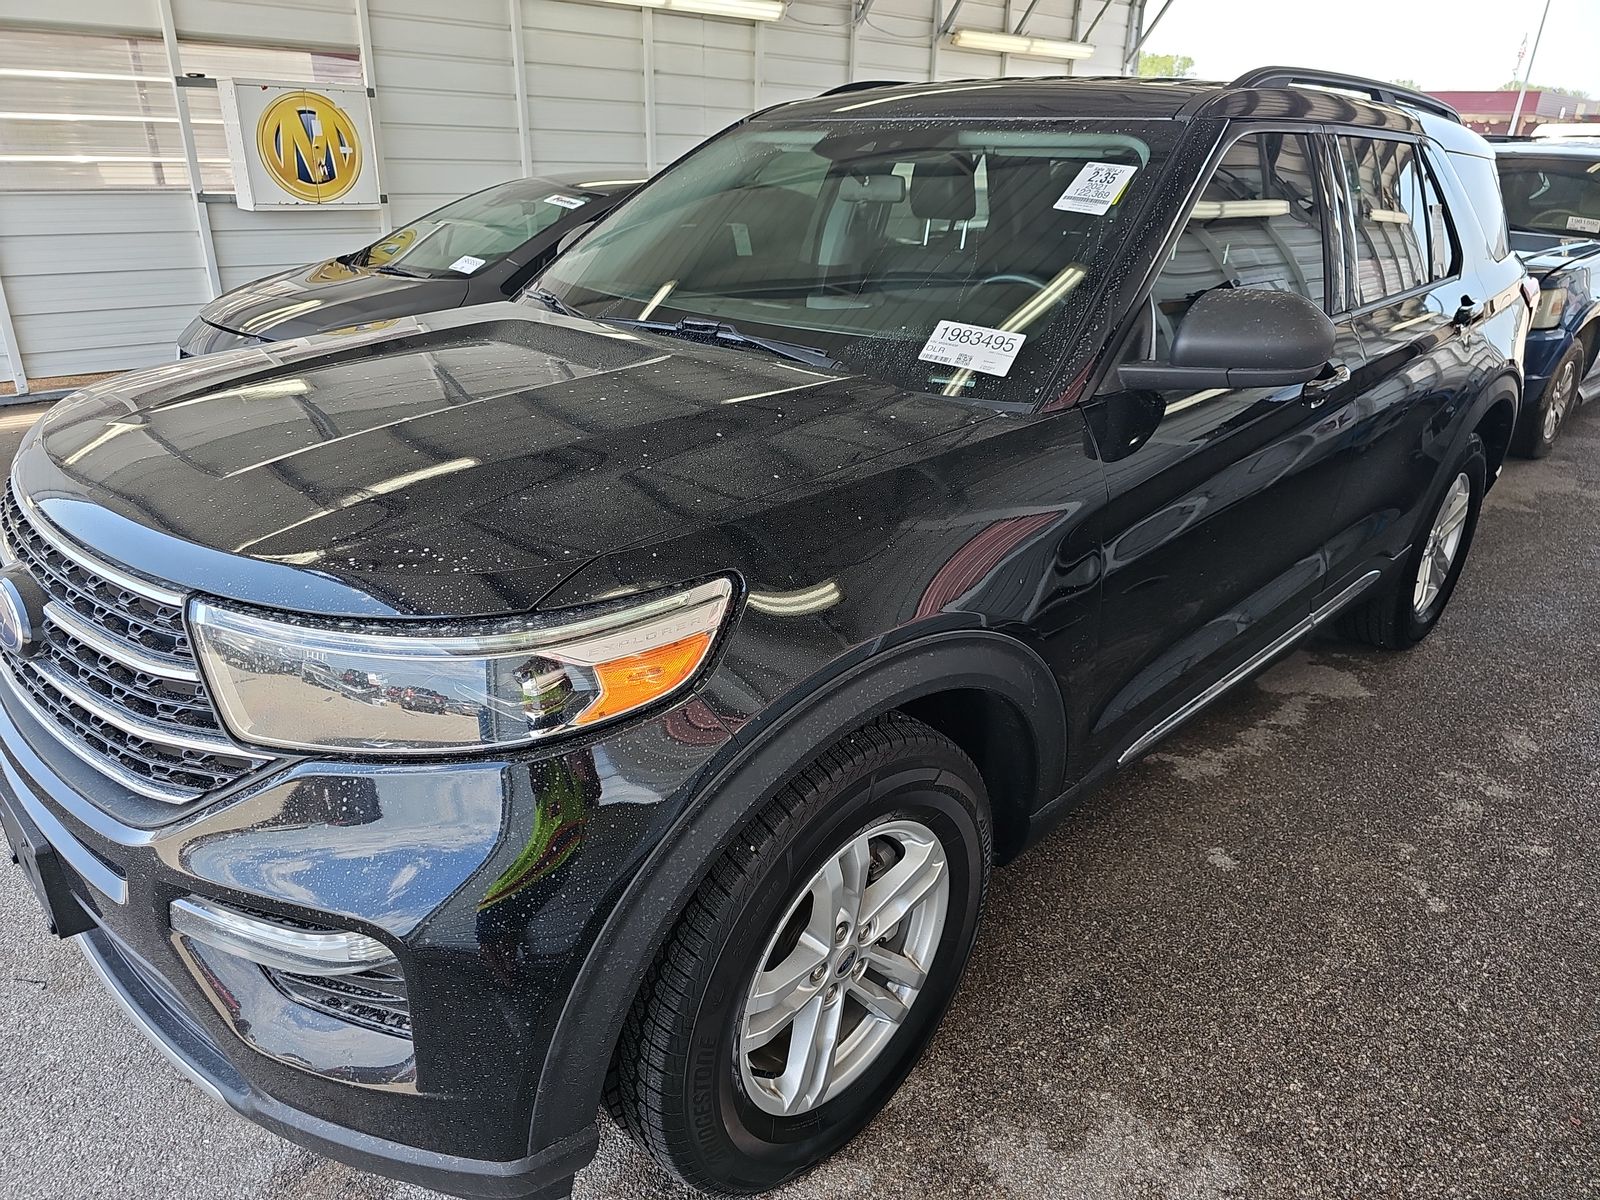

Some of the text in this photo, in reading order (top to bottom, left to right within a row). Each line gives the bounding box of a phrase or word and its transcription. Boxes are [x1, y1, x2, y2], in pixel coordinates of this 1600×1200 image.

[1087, 171, 1119, 184] 2:35
[1073, 188, 1111, 199] 122,369
[940, 325, 1017, 353] 1983495
[925, 344, 946, 354] DLR
